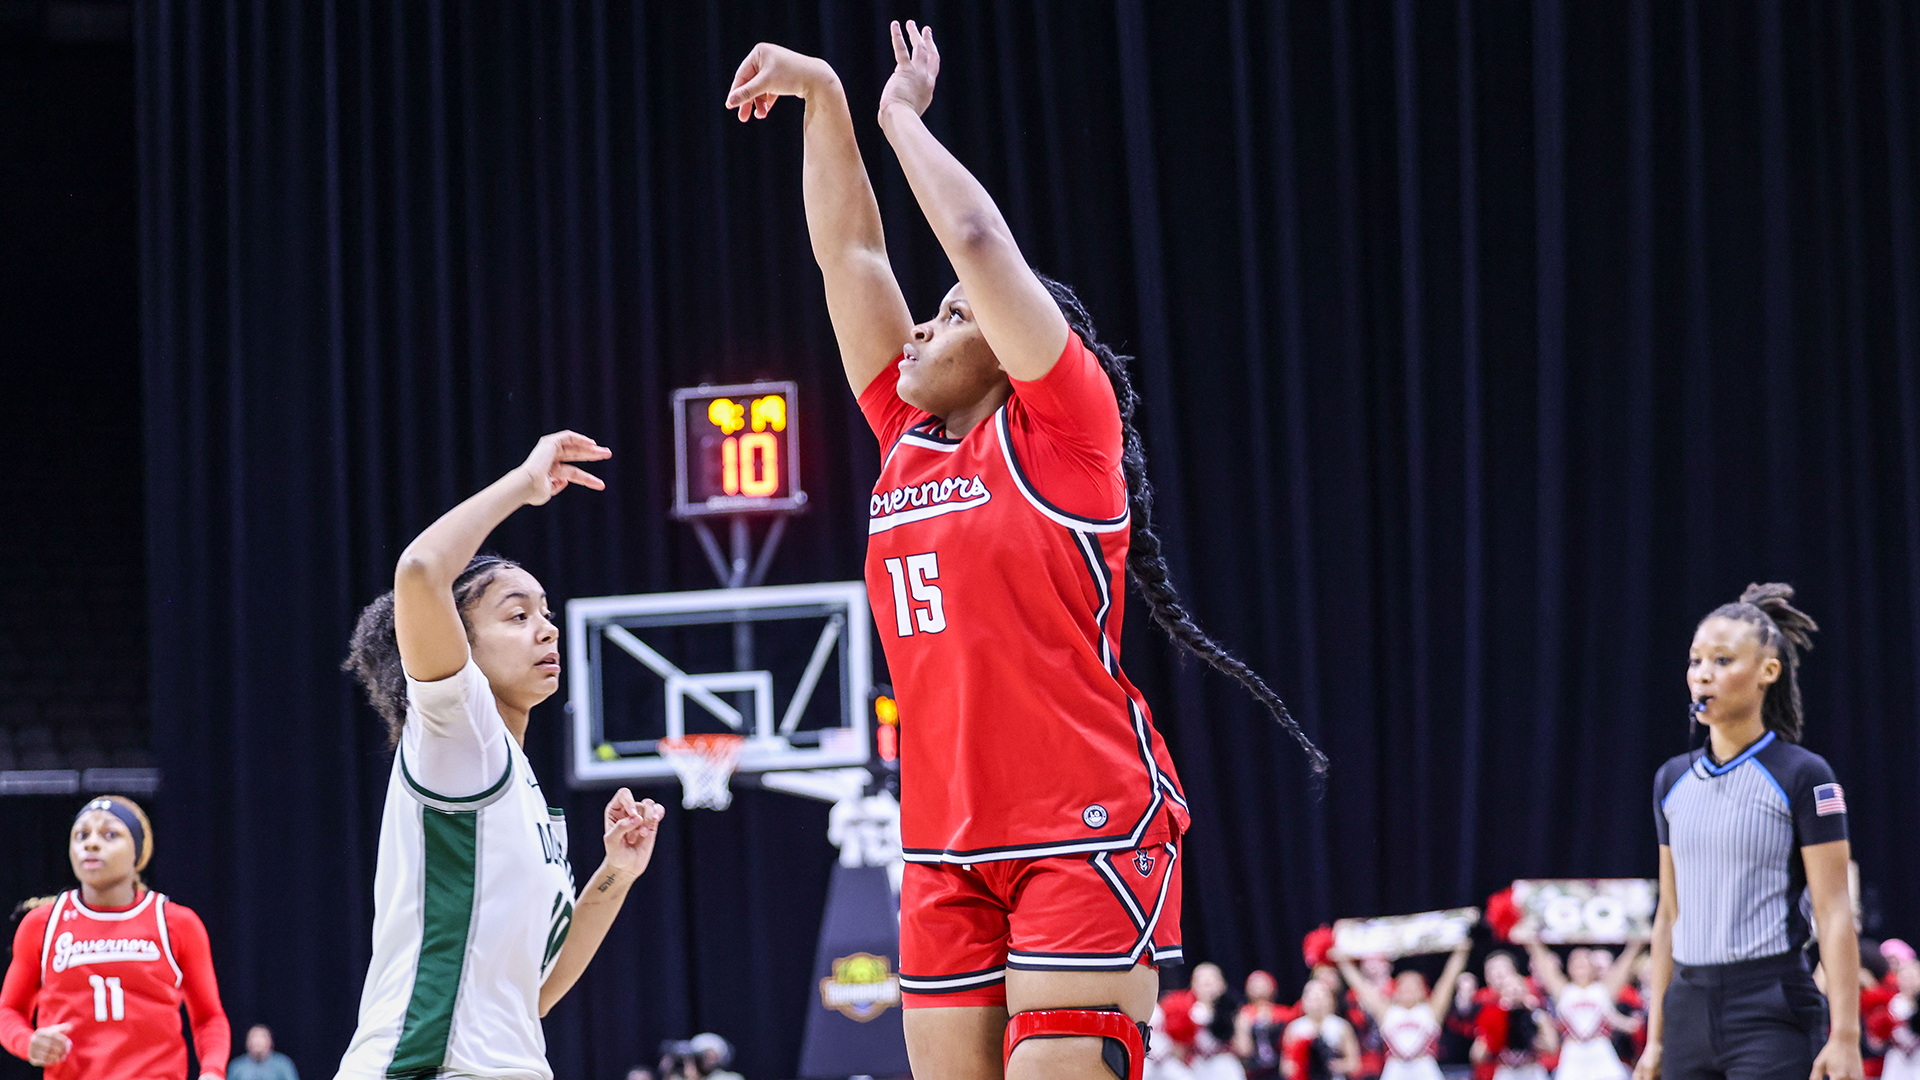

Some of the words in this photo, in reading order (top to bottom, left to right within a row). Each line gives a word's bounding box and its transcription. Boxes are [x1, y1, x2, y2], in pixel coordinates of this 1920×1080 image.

[722, 431, 779, 497] 10
[869, 474, 992, 519] overnors
[884, 551, 947, 637] 15
[53, 931, 160, 973] Governors
[89, 974, 124, 1022] 11
